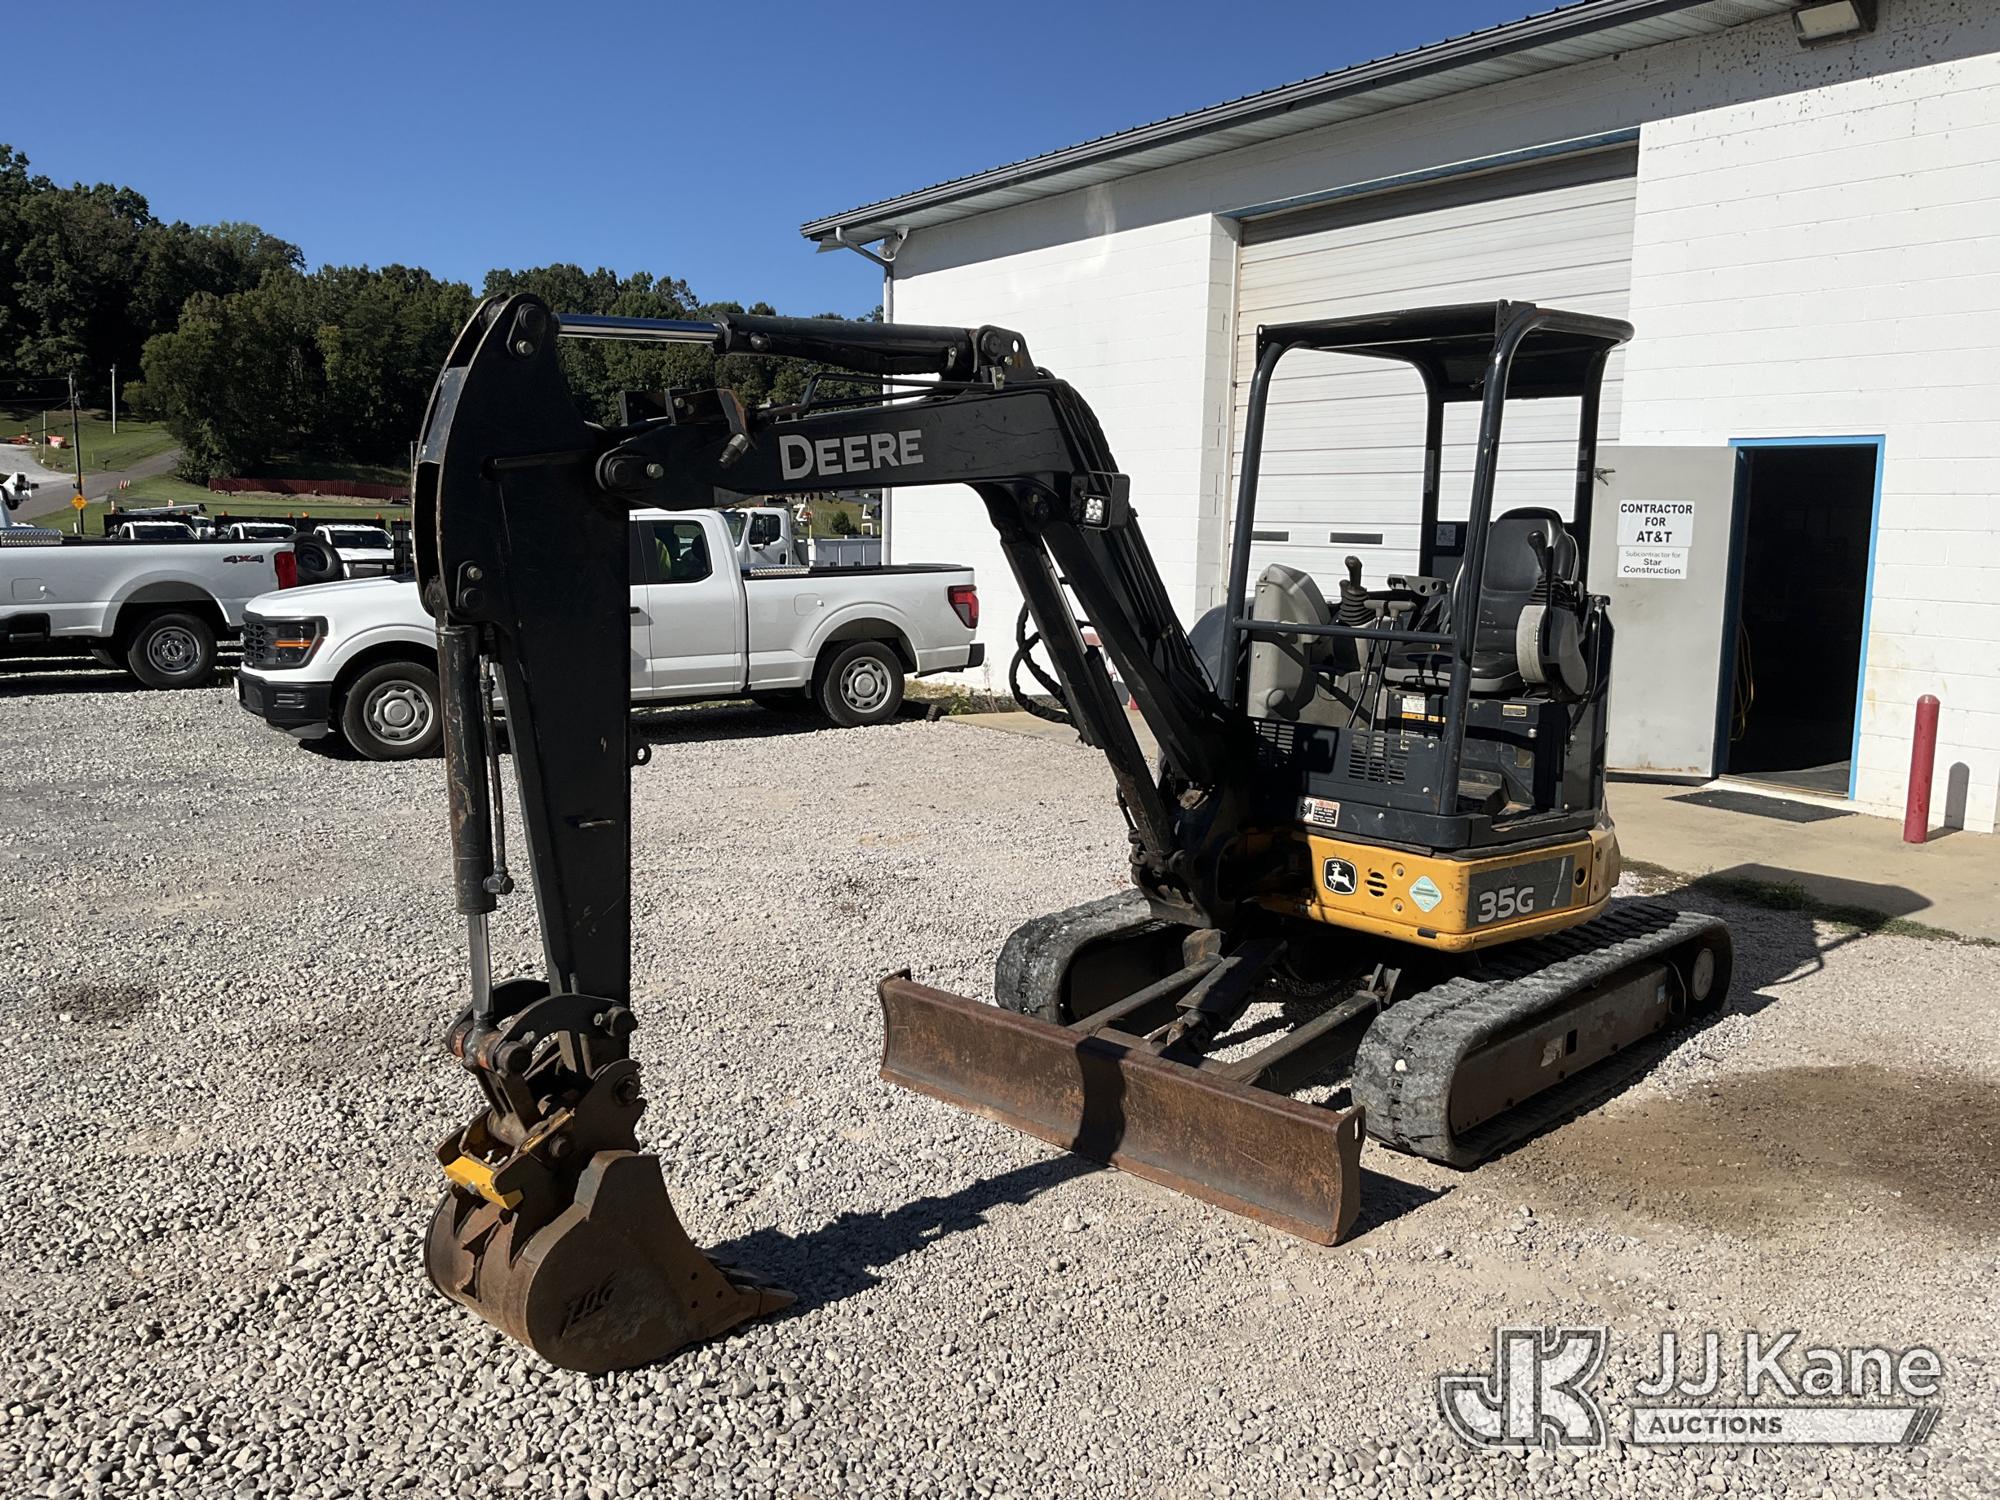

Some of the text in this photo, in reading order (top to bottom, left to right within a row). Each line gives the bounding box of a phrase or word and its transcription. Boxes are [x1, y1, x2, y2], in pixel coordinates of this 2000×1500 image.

[779, 429, 924, 481] DEERE
[1620, 503, 1693, 514] CONTRACTOR
[1645, 517, 1666, 526] FOR
[1636, 531, 1673, 543] AT&T
[1643, 558, 1662, 566] Star
[1623, 566, 1681, 575] Construction
[1477, 886, 1535, 923] 35G
